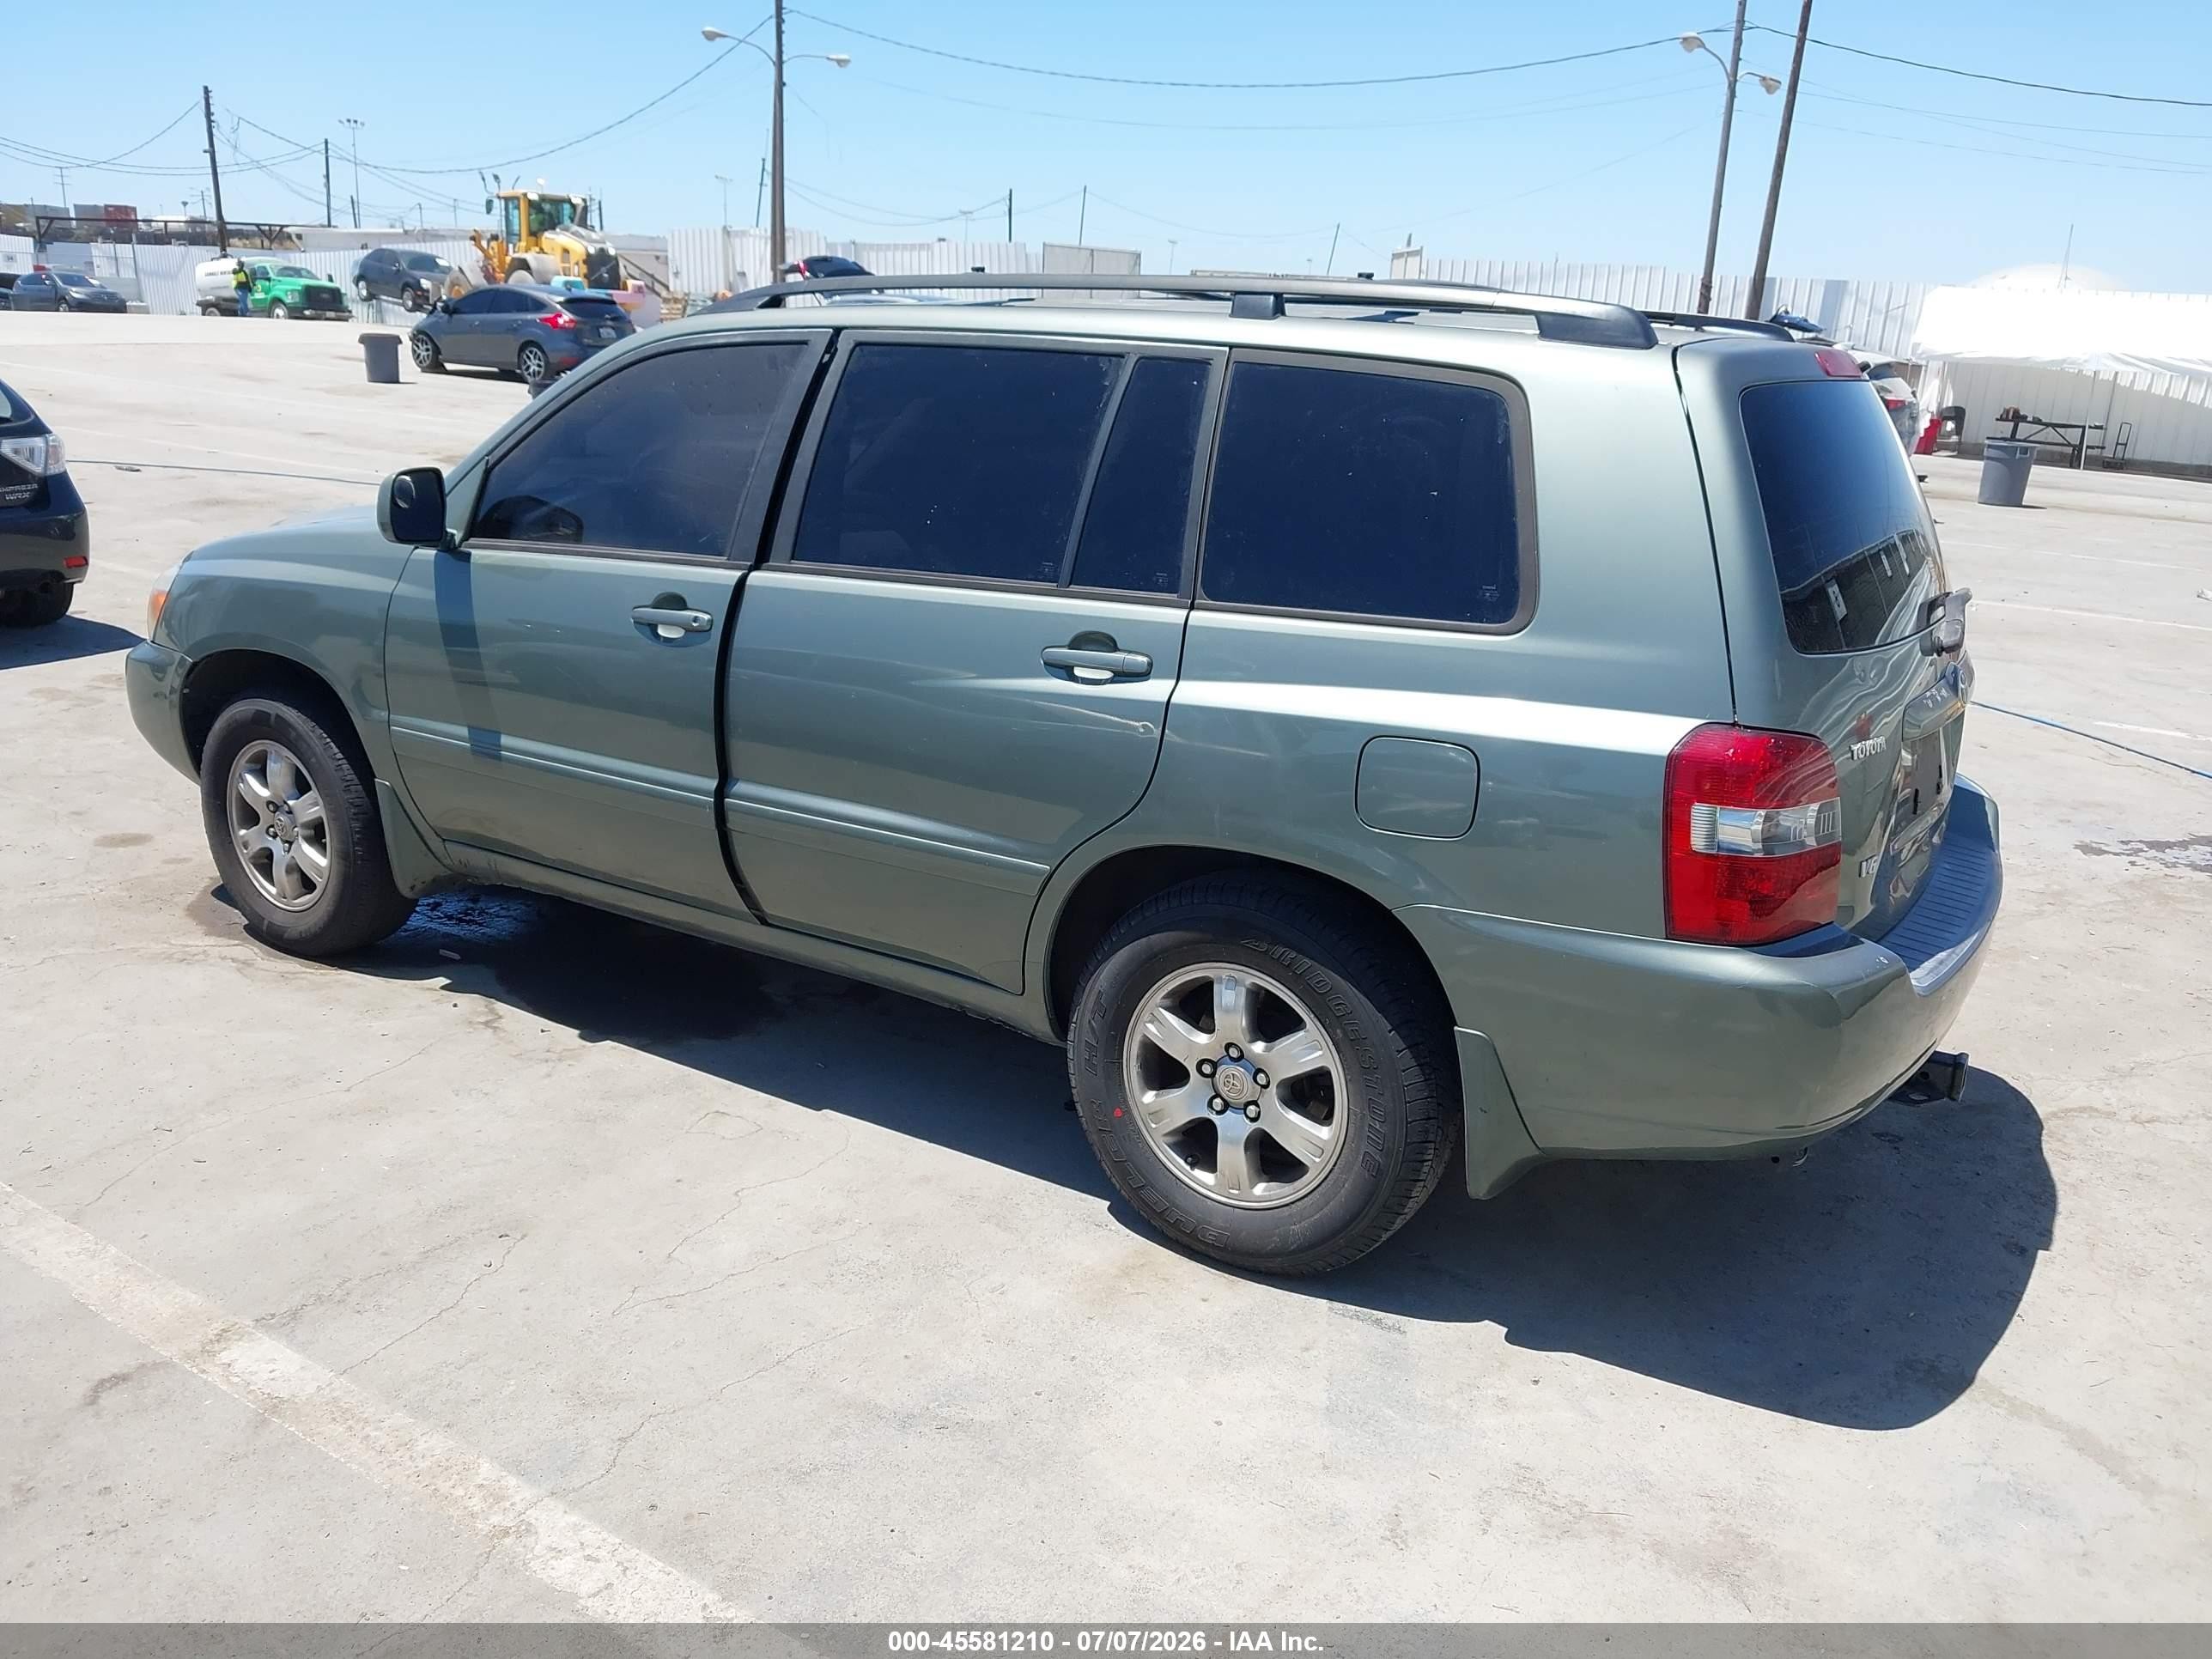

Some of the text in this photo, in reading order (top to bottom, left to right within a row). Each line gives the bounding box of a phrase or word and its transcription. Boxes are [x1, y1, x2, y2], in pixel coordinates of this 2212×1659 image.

[5, 491, 30, 500] WRX
[1850, 735, 1887, 761] TOYOTA
[1858, 854, 1879, 878] V6
[1240, 937, 1388, 1178] BRIDGESTONE
